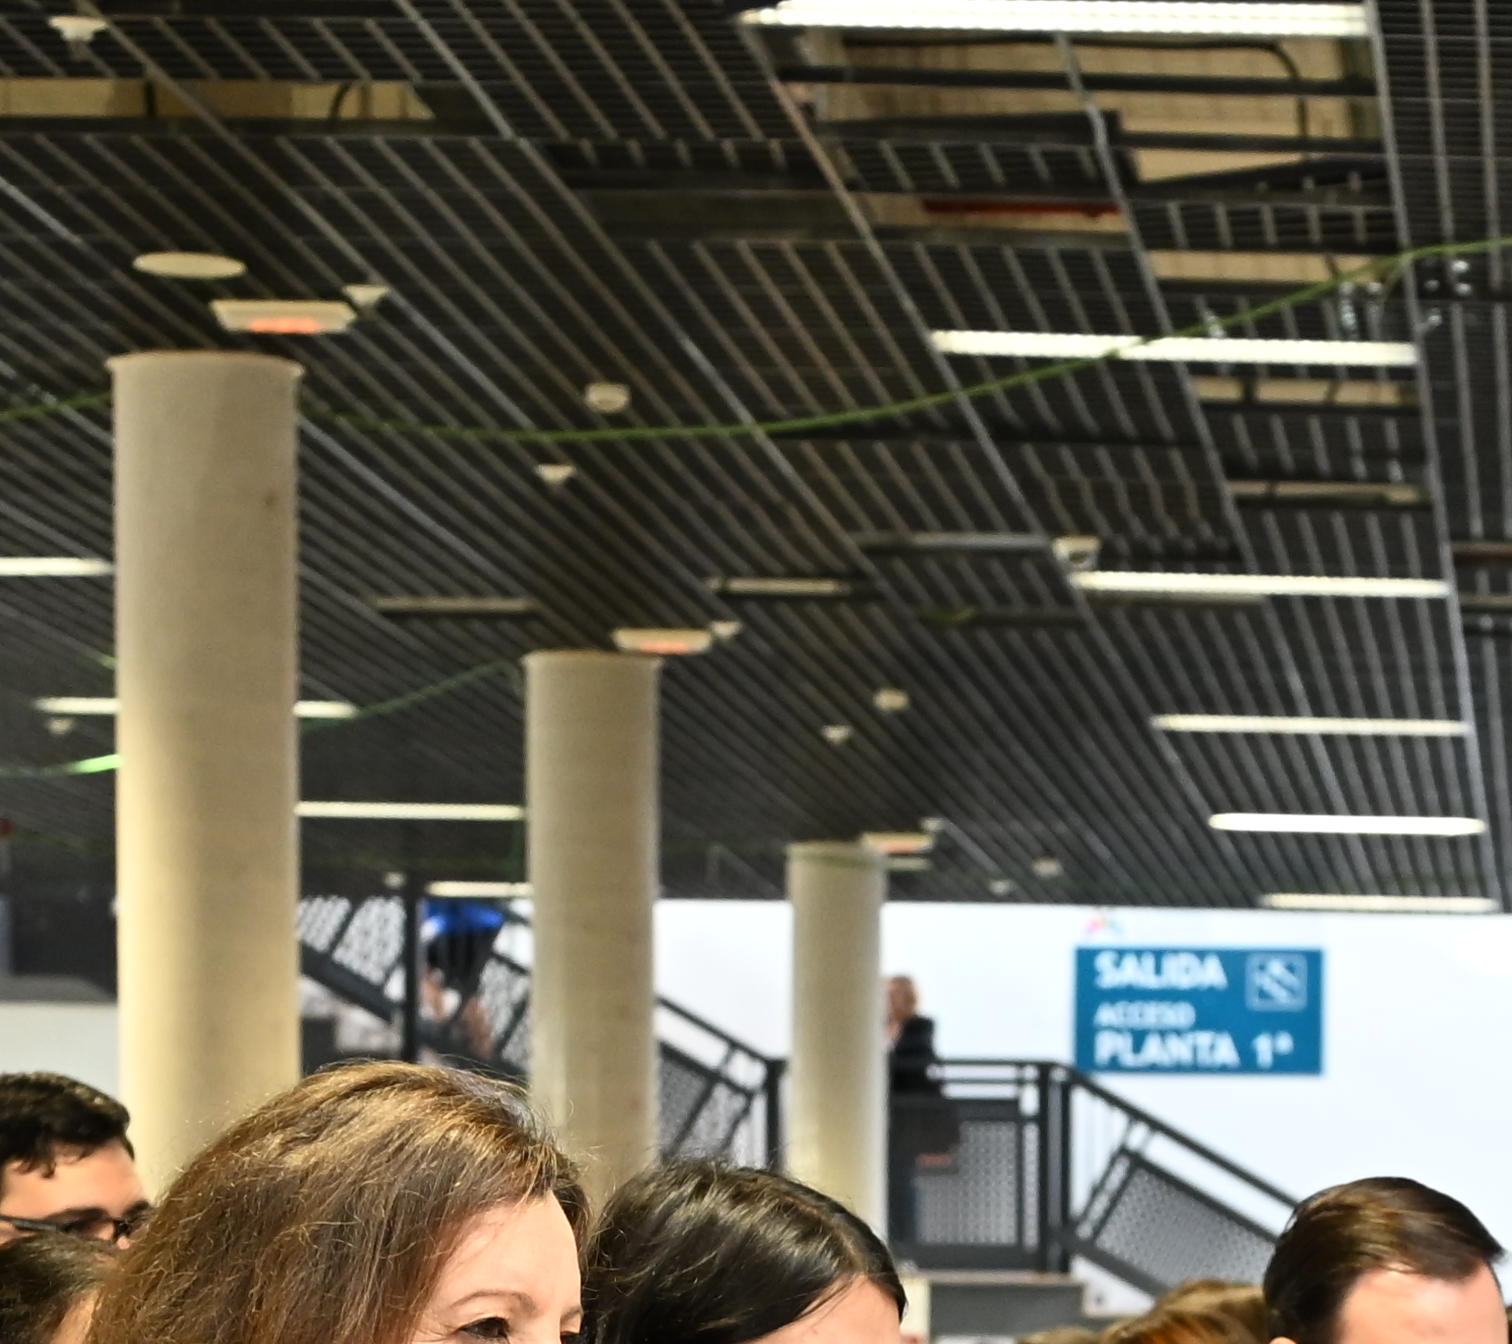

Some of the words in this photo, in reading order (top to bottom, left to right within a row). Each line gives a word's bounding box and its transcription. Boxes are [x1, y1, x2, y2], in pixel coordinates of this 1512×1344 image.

[1094, 950, 1228, 989] SALIDA
[1093, 1001, 1196, 1030] ACCESO
[1094, 1030, 1241, 1069] PLANTA
